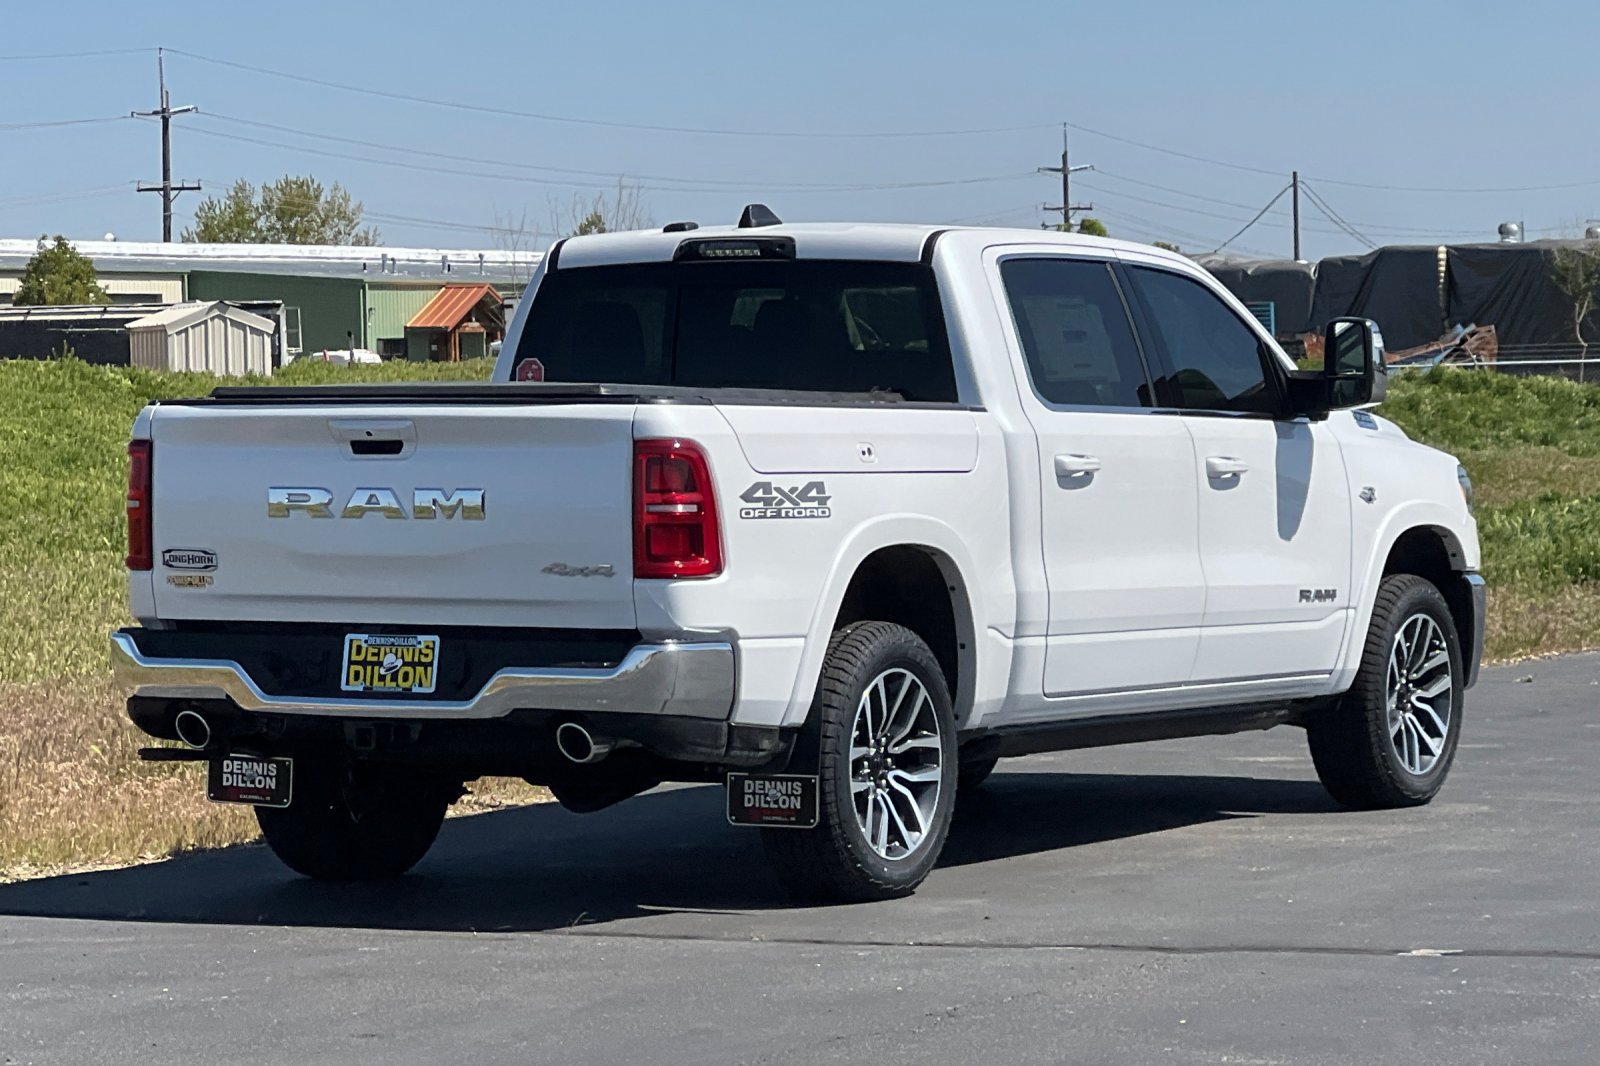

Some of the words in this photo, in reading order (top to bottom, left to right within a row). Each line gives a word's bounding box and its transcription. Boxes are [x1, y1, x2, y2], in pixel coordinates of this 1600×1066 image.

[267, 486, 487, 521] RAM
[741, 508, 777, 518] OFF
[781, 508, 829, 517] ROAD
[1299, 589, 1337, 603] RAM
[351, 639, 434, 662] DENNIS
[349, 665, 432, 688] DILLON
[223, 760, 277, 776] DENNIS
[223, 774, 276, 789] DILLON
[744, 780, 802, 795] DENNIS
[744, 794, 801, 809] DILLON
